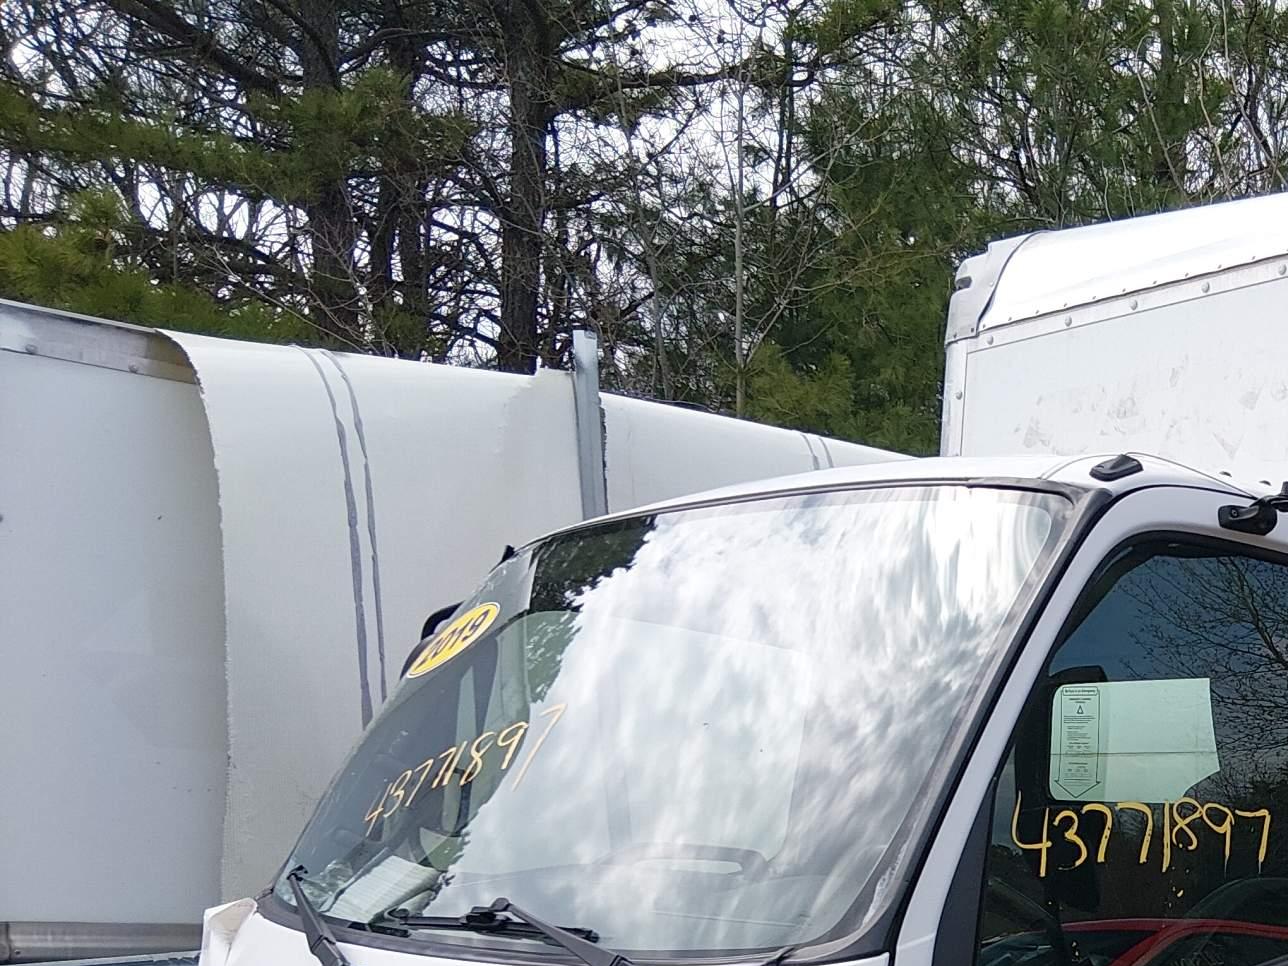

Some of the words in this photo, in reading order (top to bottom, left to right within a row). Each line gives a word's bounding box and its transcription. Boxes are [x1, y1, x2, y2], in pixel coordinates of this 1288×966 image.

[412, 608, 491, 668] 2019
[364, 703, 568, 838] 43771897
[1011, 790, 1272, 878] 43771897
